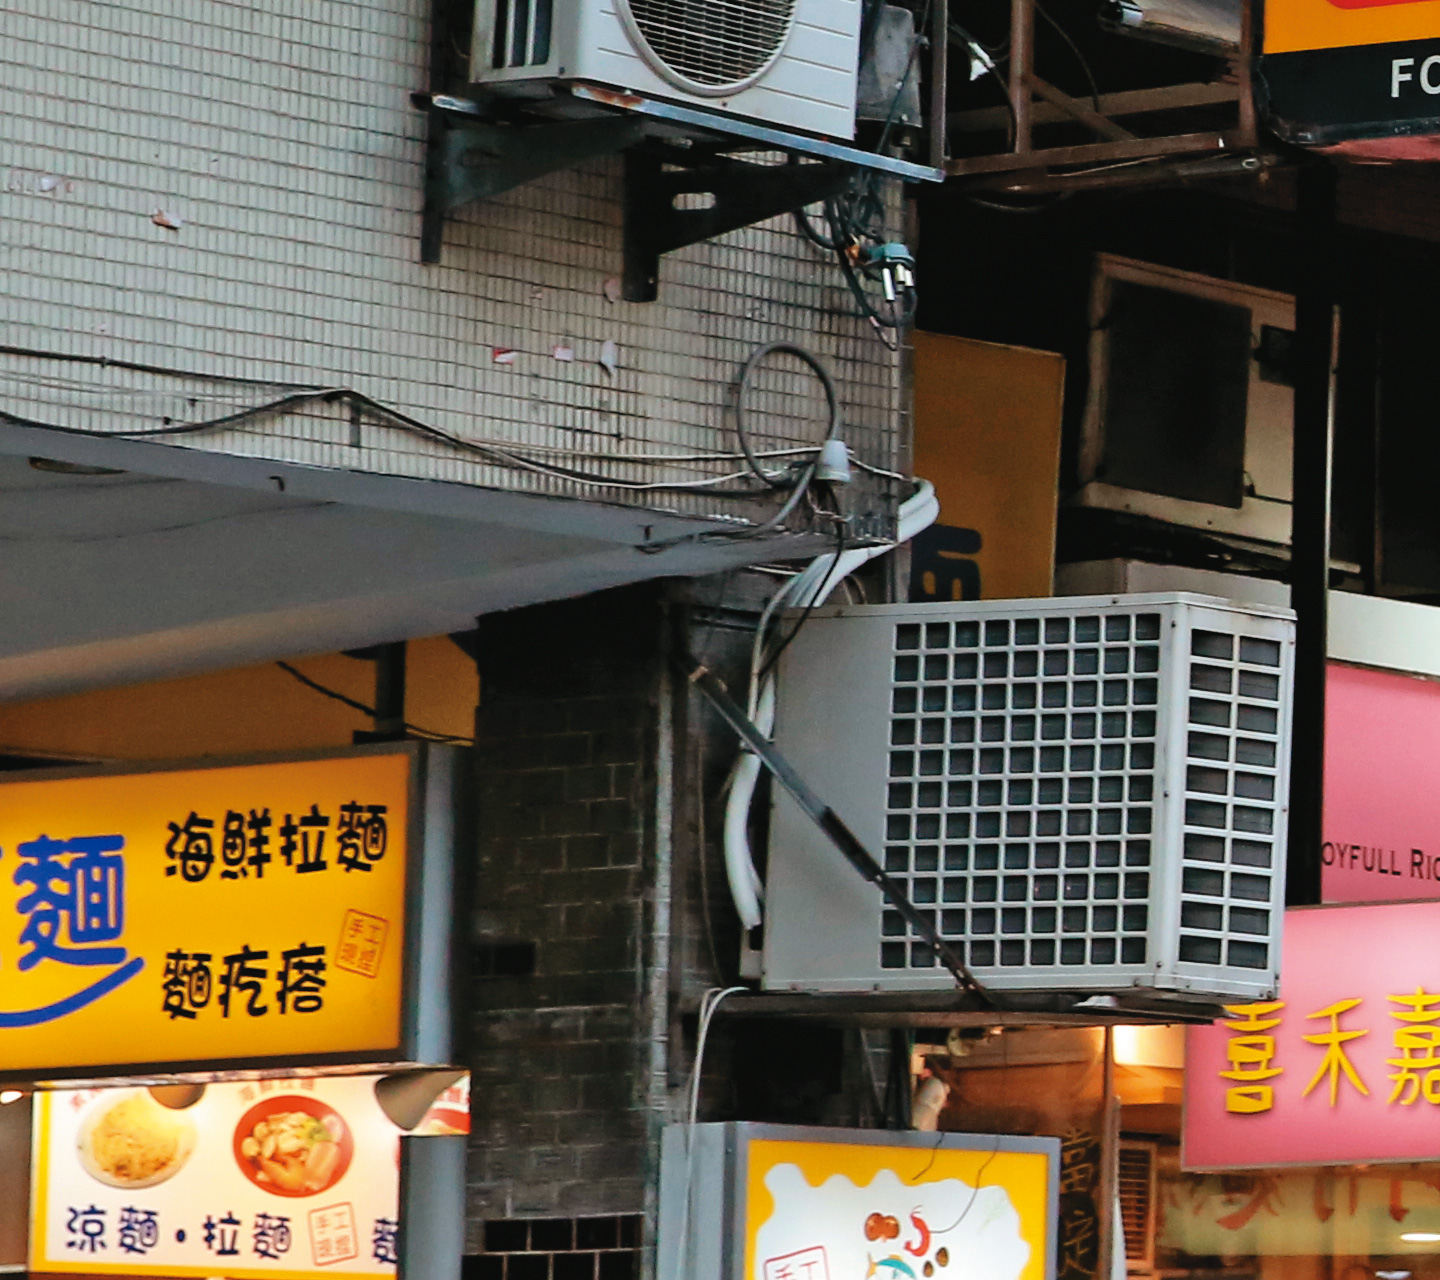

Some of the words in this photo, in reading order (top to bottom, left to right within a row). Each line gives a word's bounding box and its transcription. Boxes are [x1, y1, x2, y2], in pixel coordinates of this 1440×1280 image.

[165, 799, 389, 884] 海鮮拉麵
[1321, 841, 1402, 878] OYFULL
[161, 941, 327, 1020] 麵疙瘩
